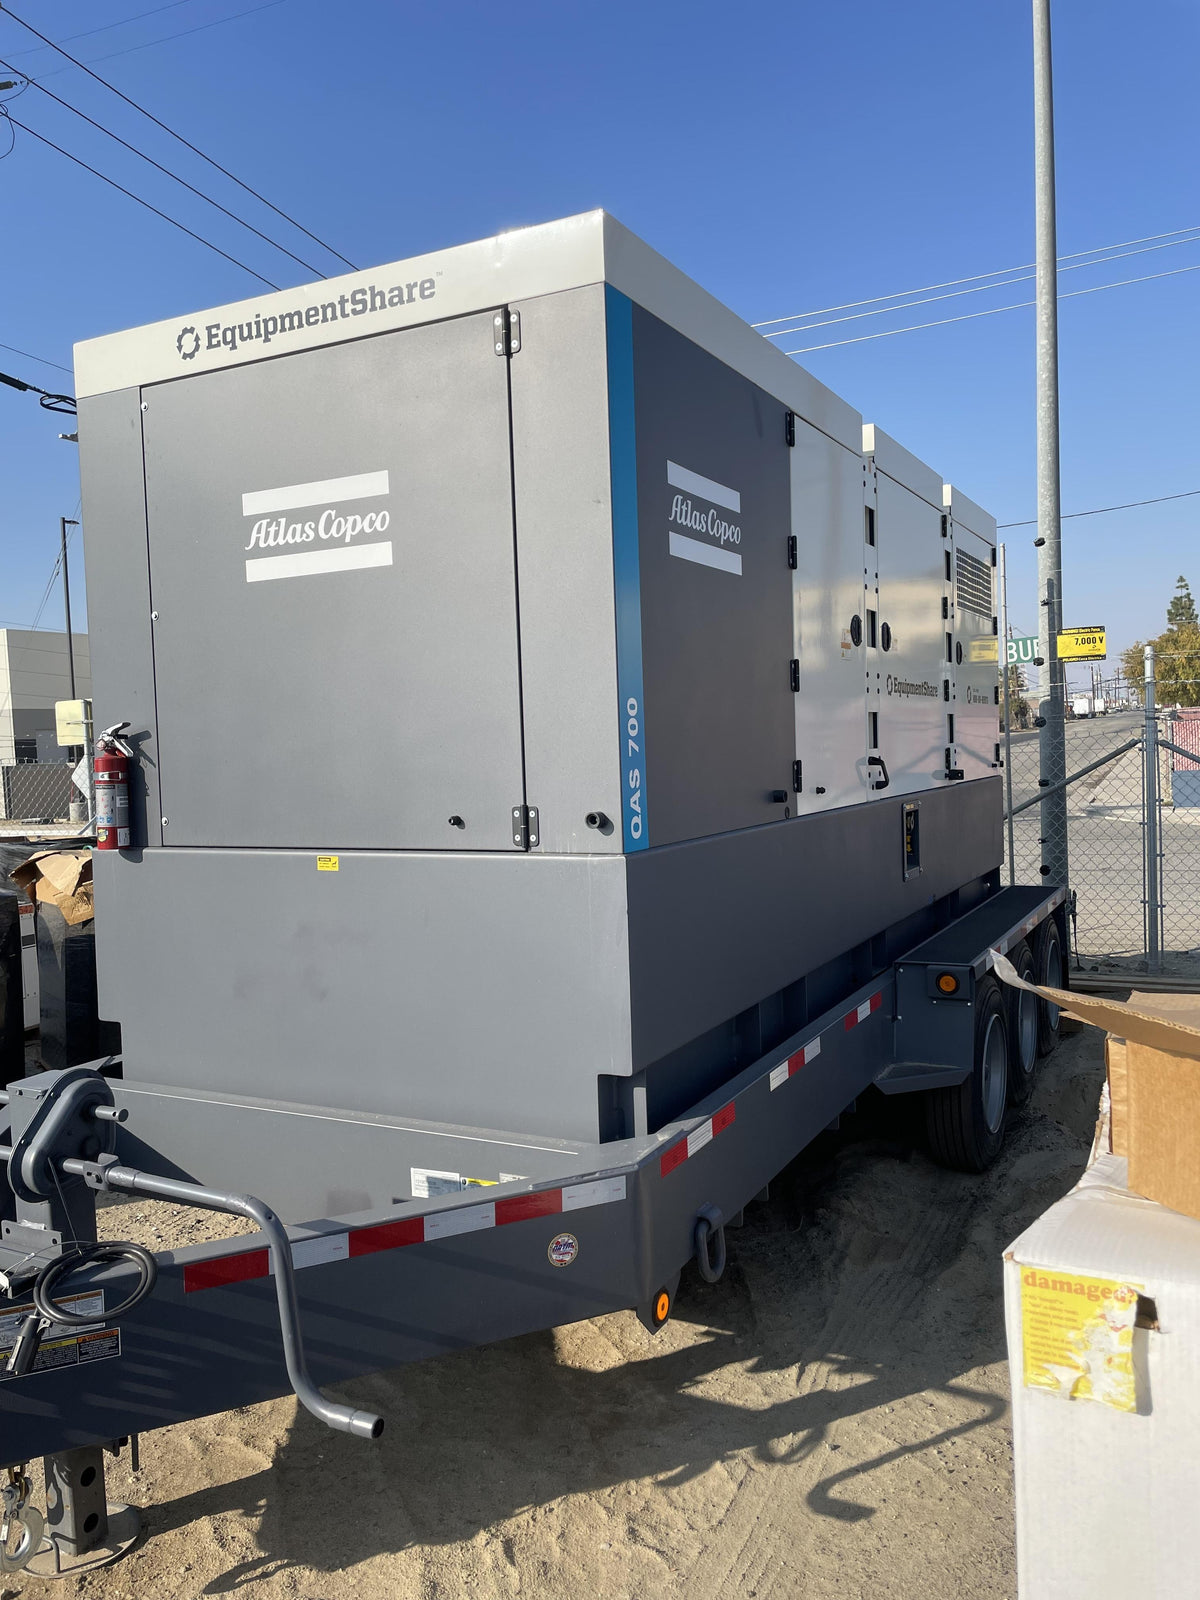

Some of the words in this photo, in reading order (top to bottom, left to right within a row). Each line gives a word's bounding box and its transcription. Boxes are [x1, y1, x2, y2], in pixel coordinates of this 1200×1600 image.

[205, 277, 437, 352] EquipmentShare
[245, 517, 316, 550] Atlas
[318, 509, 390, 543] Copco
[668, 494, 707, 533] Atlas
[707, 508, 742, 545] Copco
[1075, 637, 1097, 647] 7,000
[1098, 636, 1104, 644] V
[893, 677, 938, 698] EquipmentShare
[626, 697, 640, 757] 700
[628, 768, 642, 840] QAS
